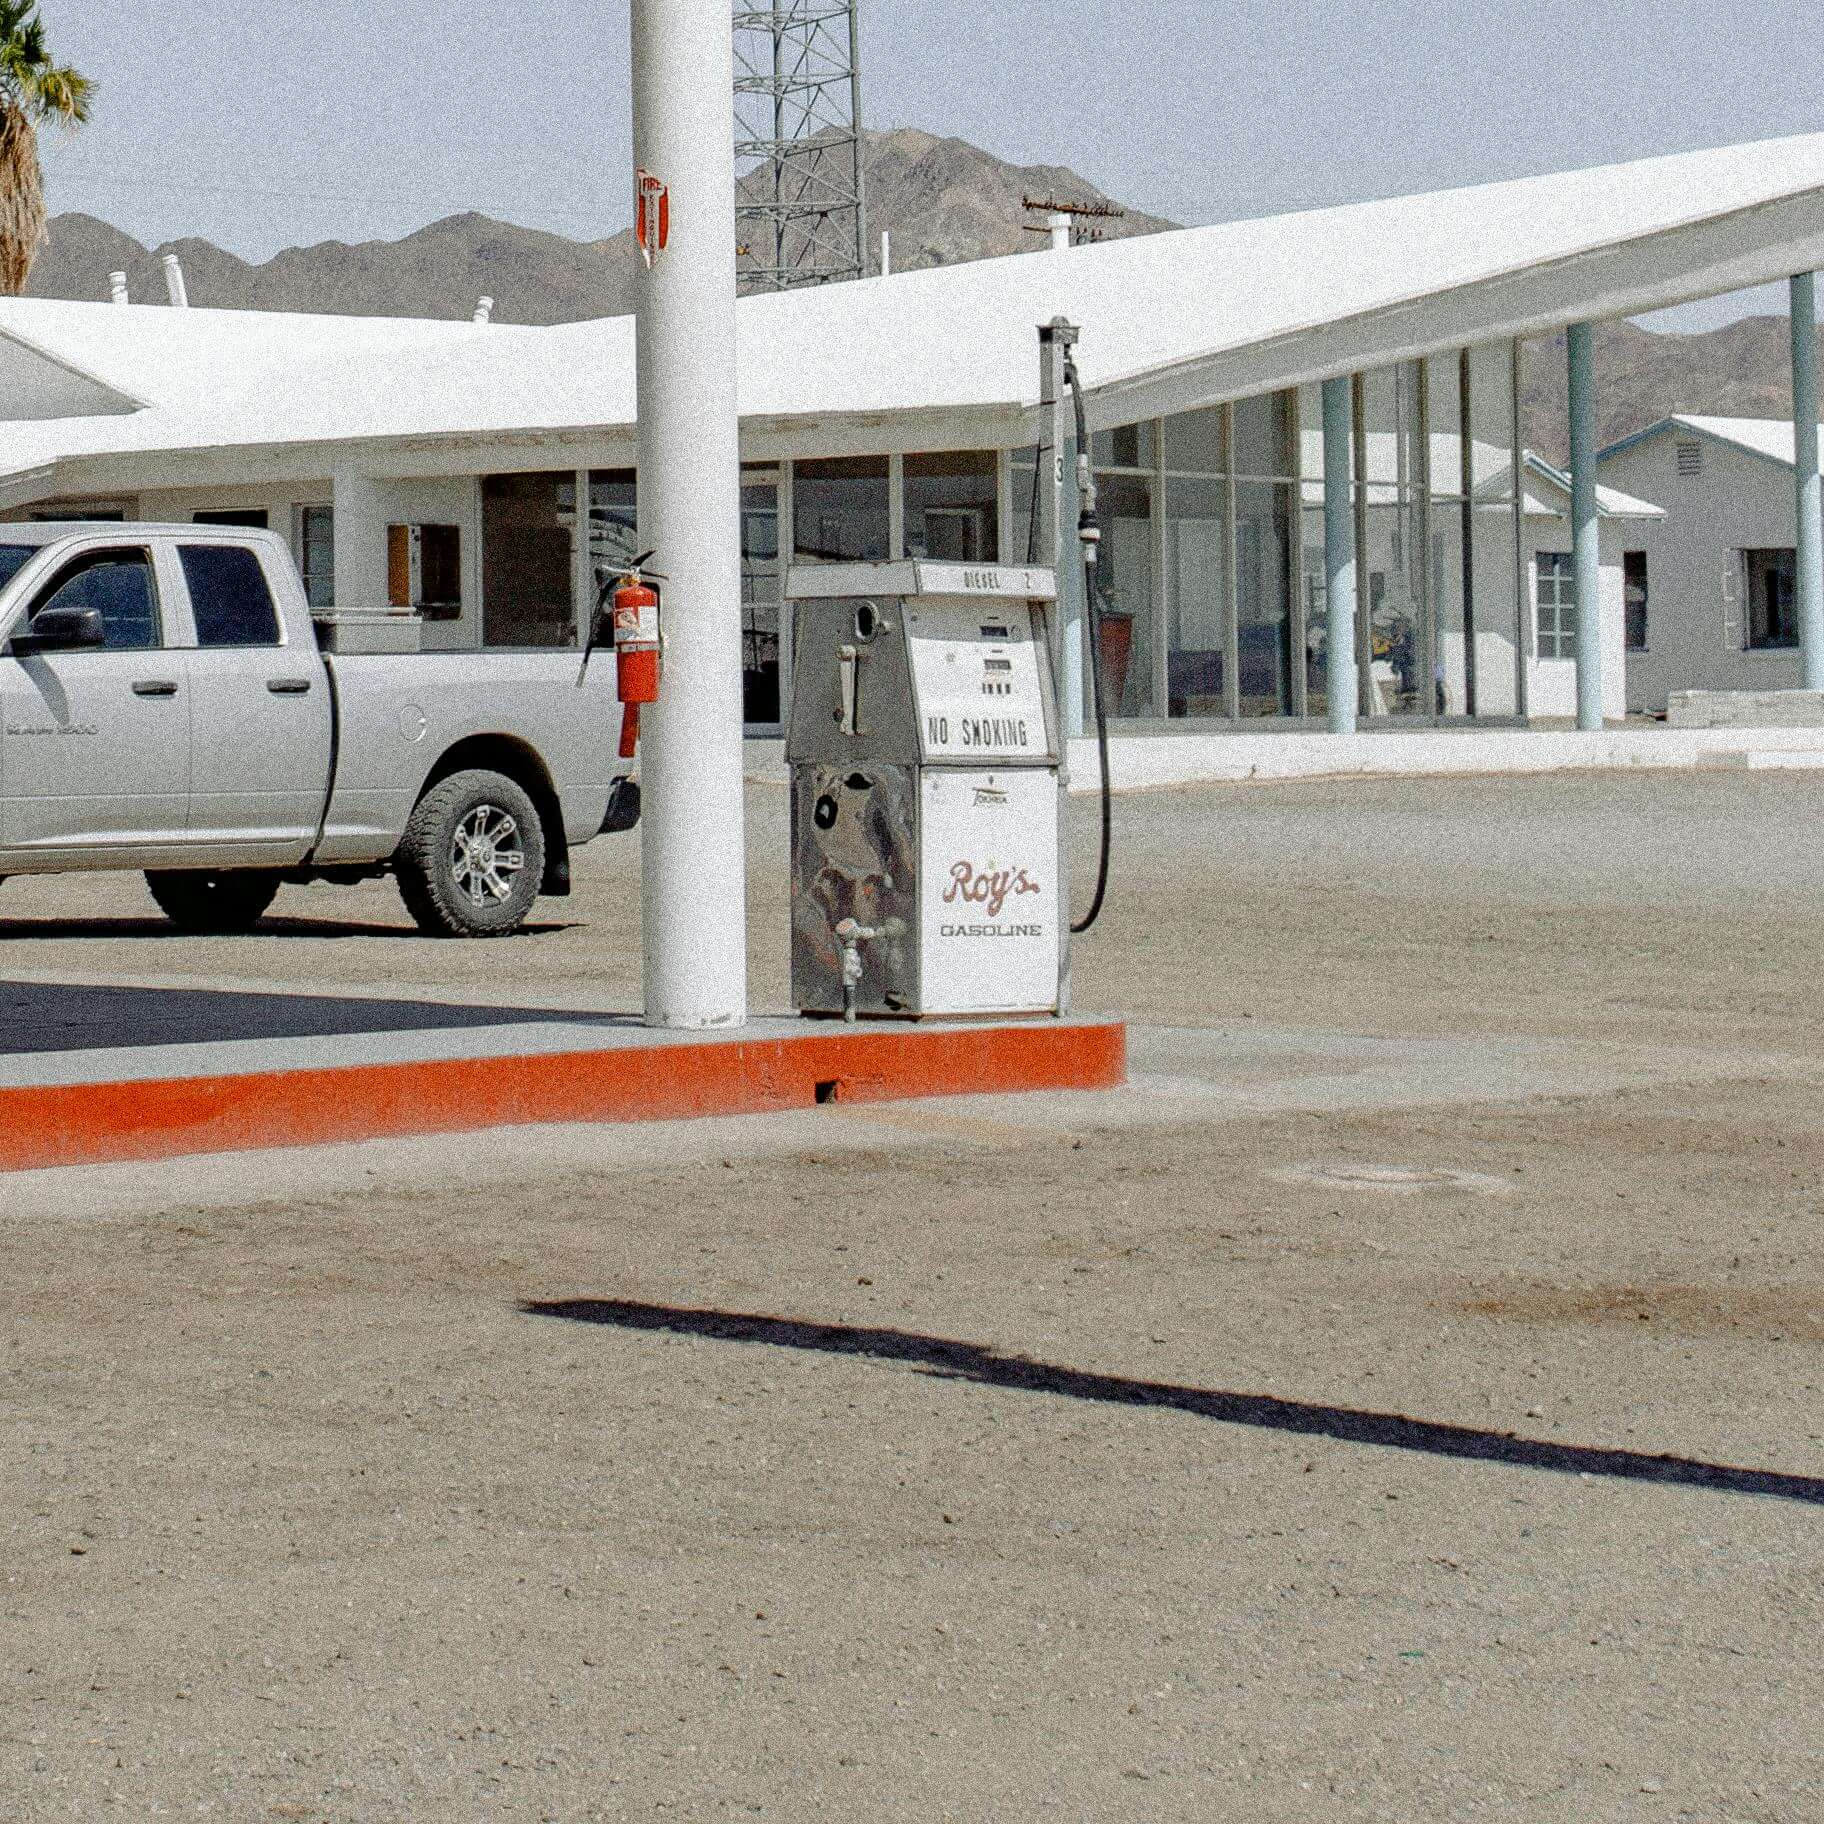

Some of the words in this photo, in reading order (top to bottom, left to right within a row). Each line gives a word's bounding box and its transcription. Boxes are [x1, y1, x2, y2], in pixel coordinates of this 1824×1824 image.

[1055, 457, 1064, 482] 3
[964, 571, 1000, 589] DIESEL
[928, 717, 948, 744] NO
[962, 718, 1028, 746] SMOKING
[942, 860, 1041, 918] Roy's
[940, 925, 1042, 937] GASOLINE
